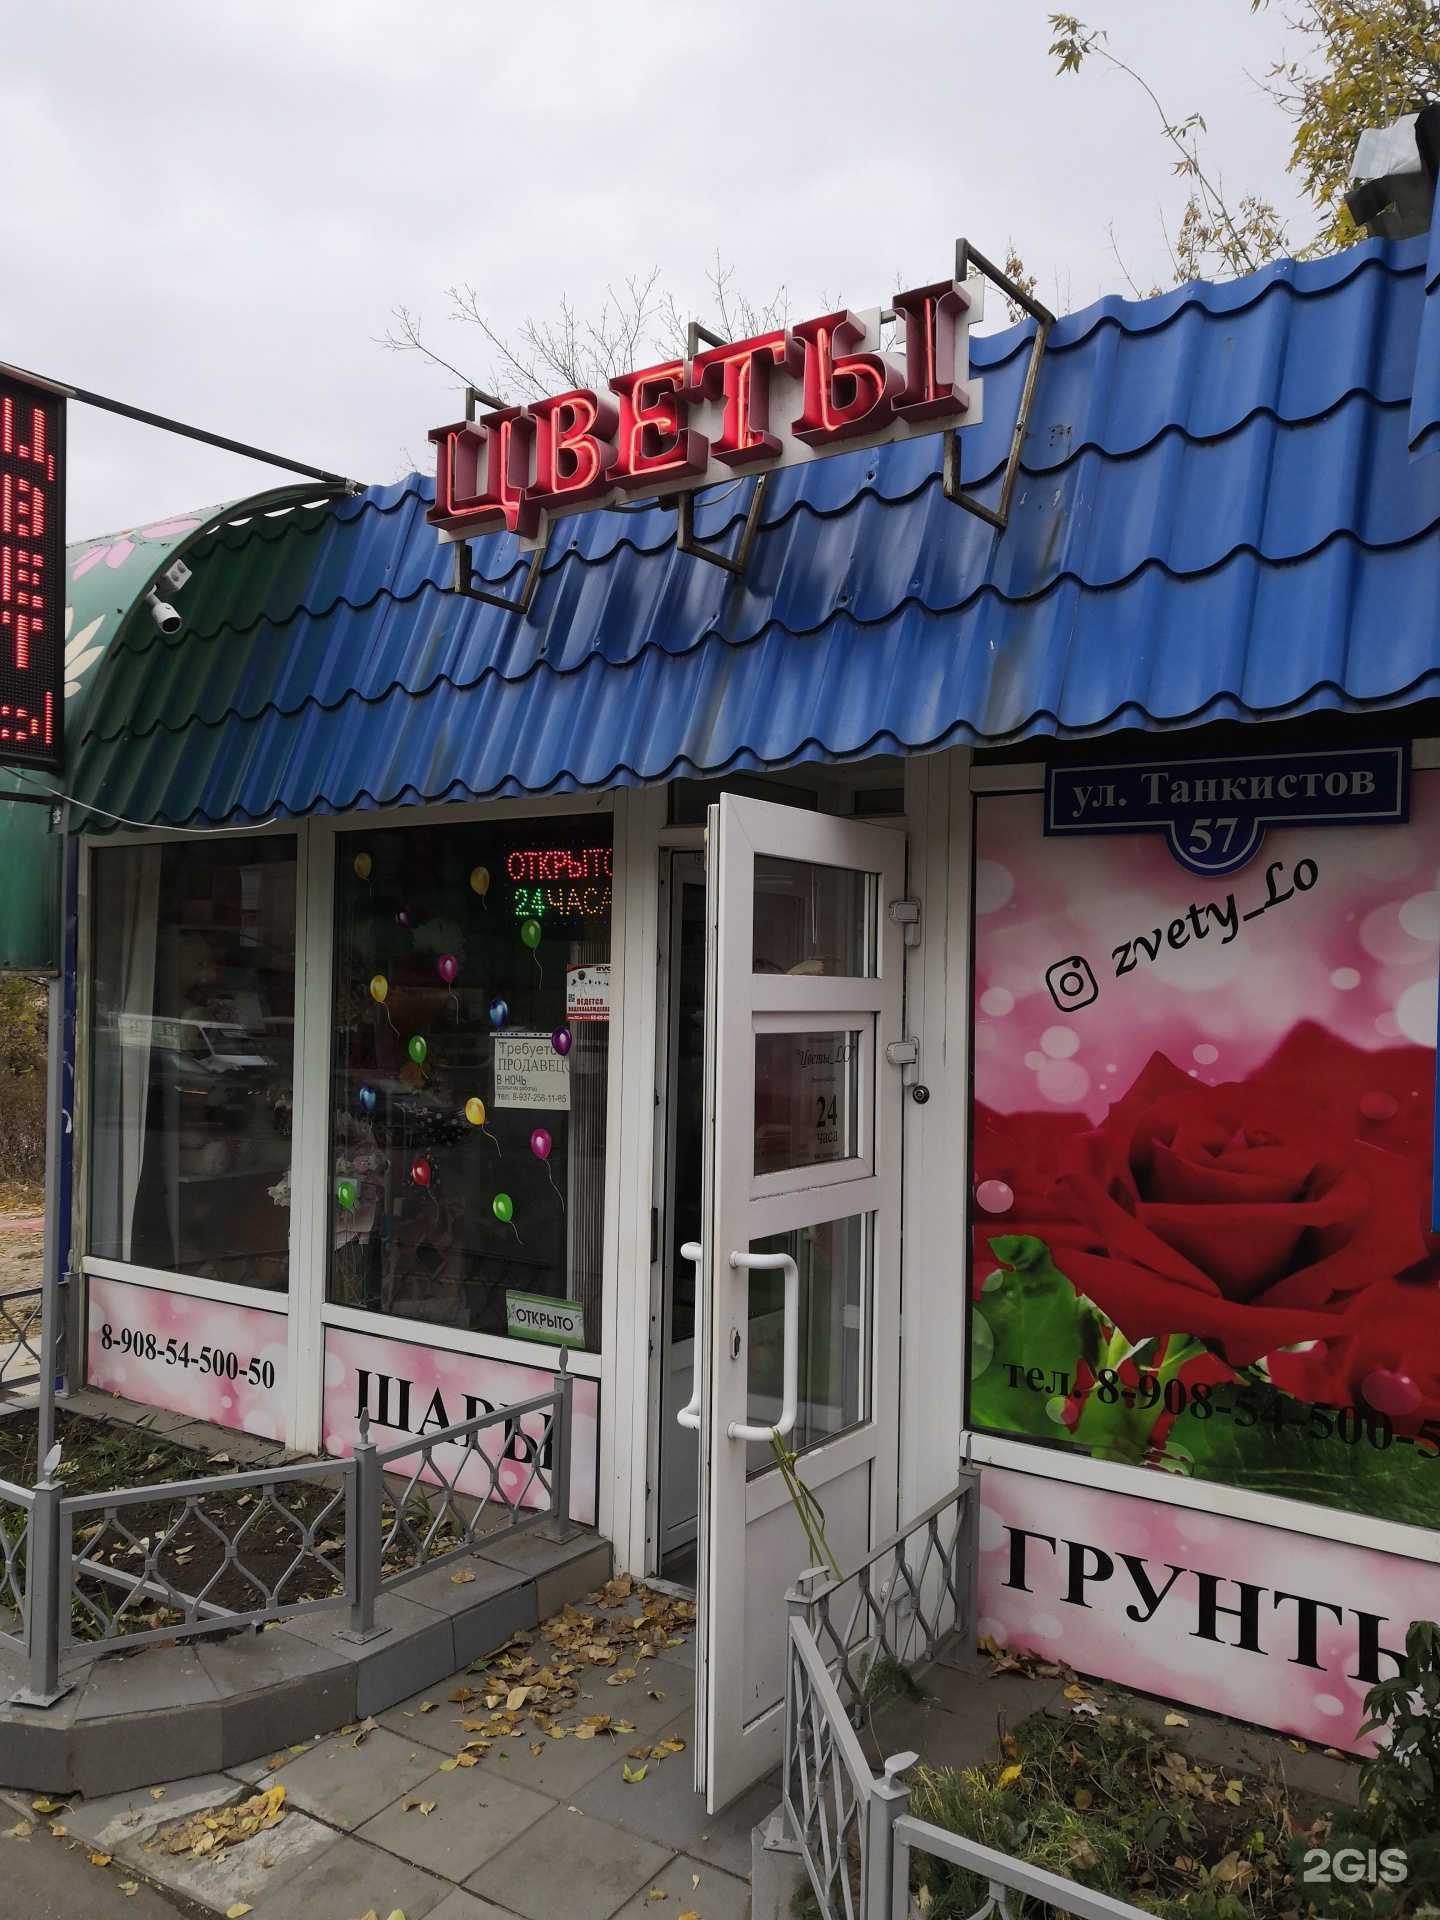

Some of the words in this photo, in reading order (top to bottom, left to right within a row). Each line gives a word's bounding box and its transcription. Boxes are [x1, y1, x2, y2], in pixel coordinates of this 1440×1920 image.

[427, 279, 972, 541] ЦВЕТЫ
[1071, 783, 1128, 817] ул.
[1140, 770, 1377, 806] Танкистов
[1188, 816, 1240, 854] 57
[514, 887, 546, 916] 24
[1111, 858, 1319, 978] zvety_Lo
[498, 1058, 566, 1073] ПРОДАВЕЦ
[816, 1096, 838, 1128] 24
[516, 1308, 574, 1331] ОТКРЫТО
[101, 1323, 275, 1389] 8-908-54-500-50
[1003, 1363, 1083, 1398] тел.
